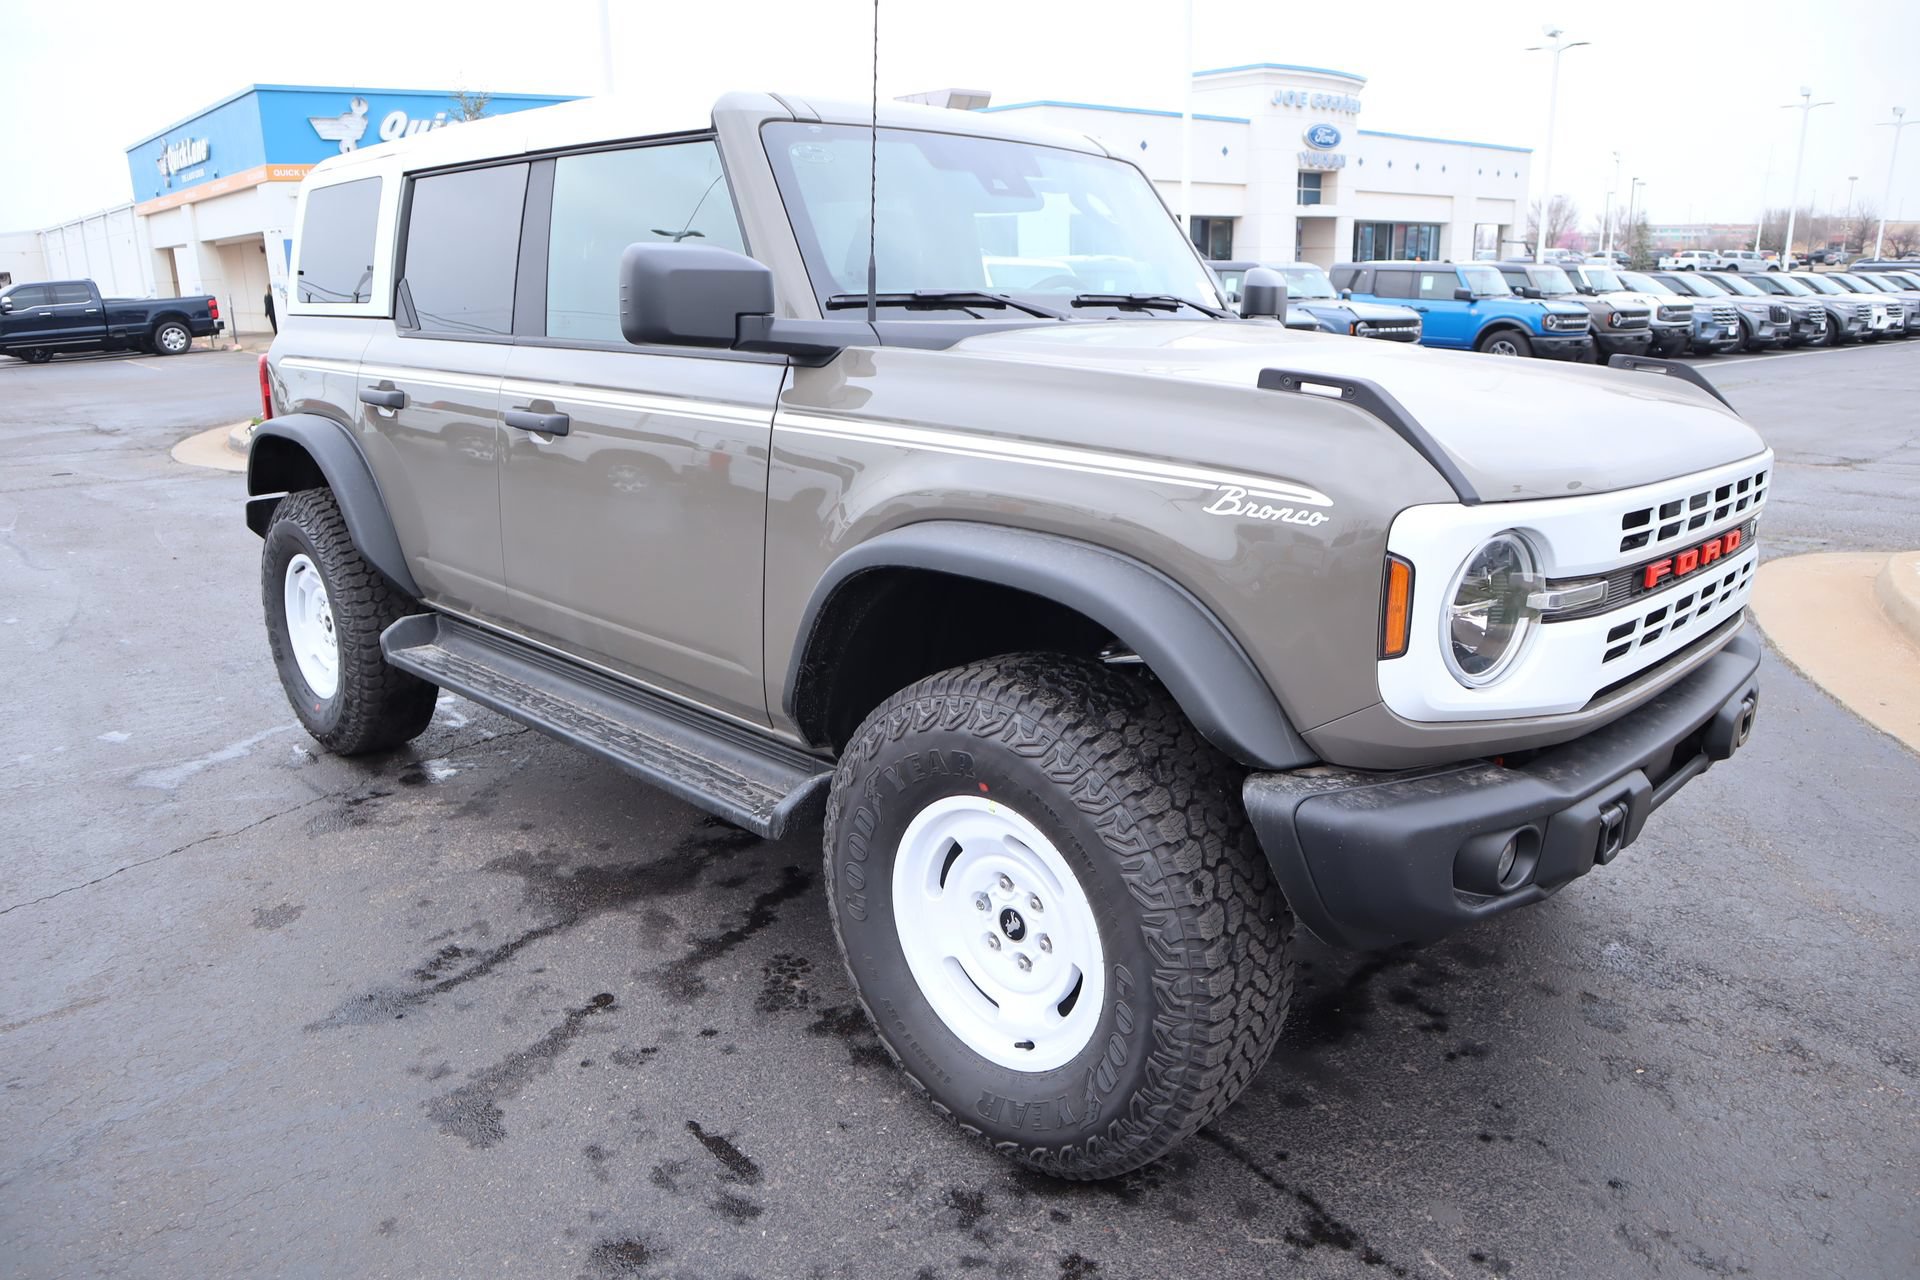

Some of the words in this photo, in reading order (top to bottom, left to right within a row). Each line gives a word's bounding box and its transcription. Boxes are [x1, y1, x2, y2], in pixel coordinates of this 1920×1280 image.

[1271, 89, 1308, 107] JOE
[1314, 127, 1337, 144] Ford
[273, 168, 301, 177] QUICK
[1202, 485, 1329, 527] Bronco
[1644, 528, 1742, 589] FORD
